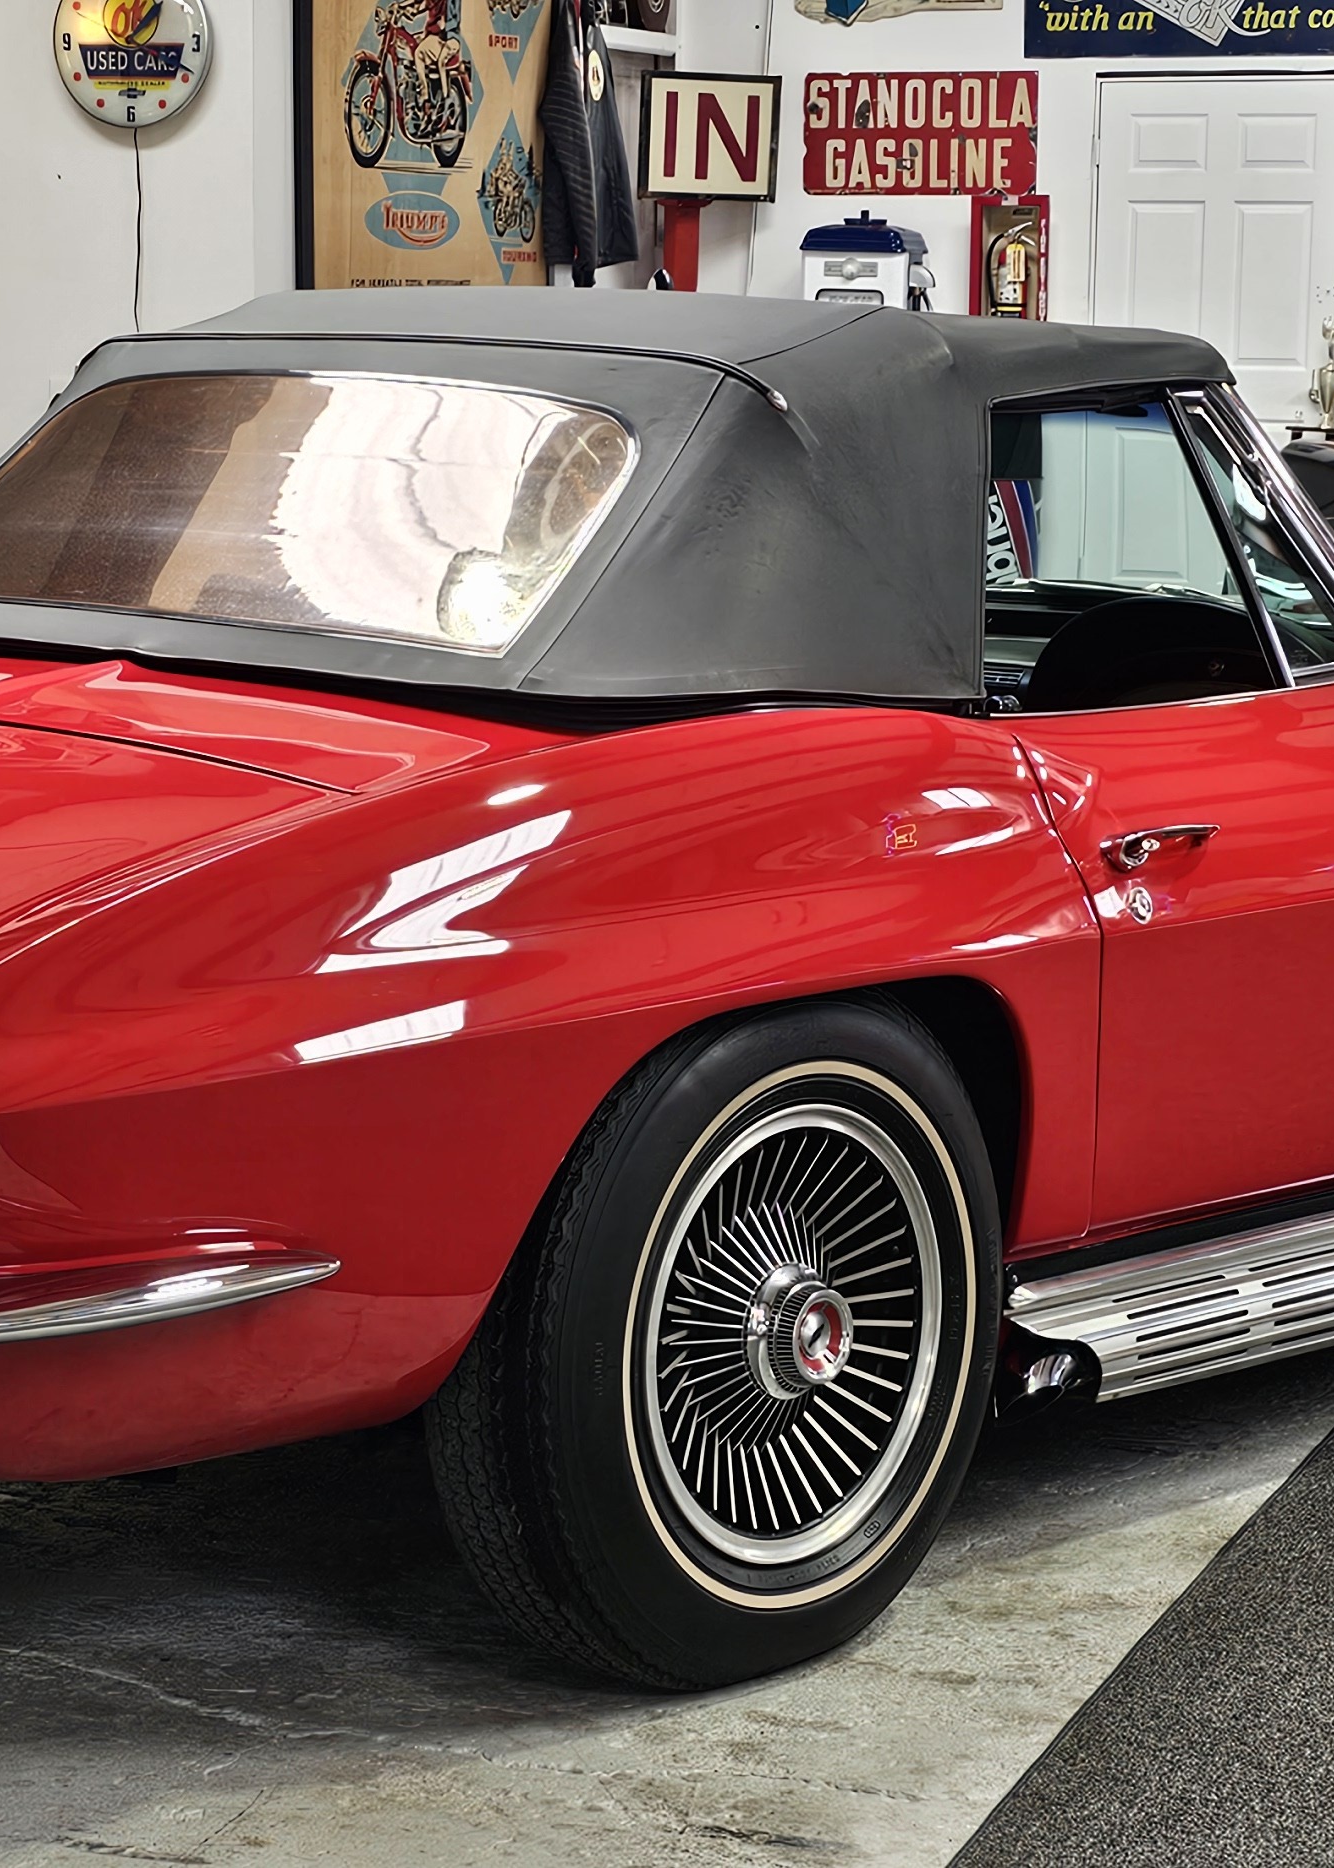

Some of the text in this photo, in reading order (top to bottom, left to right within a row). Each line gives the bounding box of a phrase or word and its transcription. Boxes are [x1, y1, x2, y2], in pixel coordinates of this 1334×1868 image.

[1117, 11, 1155, 31] an
[1242, 2, 1300, 29] that
[488, 34, 518, 49] SPORT
[86, 51, 178, 71] USED CARS
[126, 105, 135, 122] 6
[809, 78, 1033, 129] STANOCOLA
[663, 90, 760, 182] IN
[825, 138, 1012, 188] GASOLINE
[502, 250, 538, 263] TOURING
